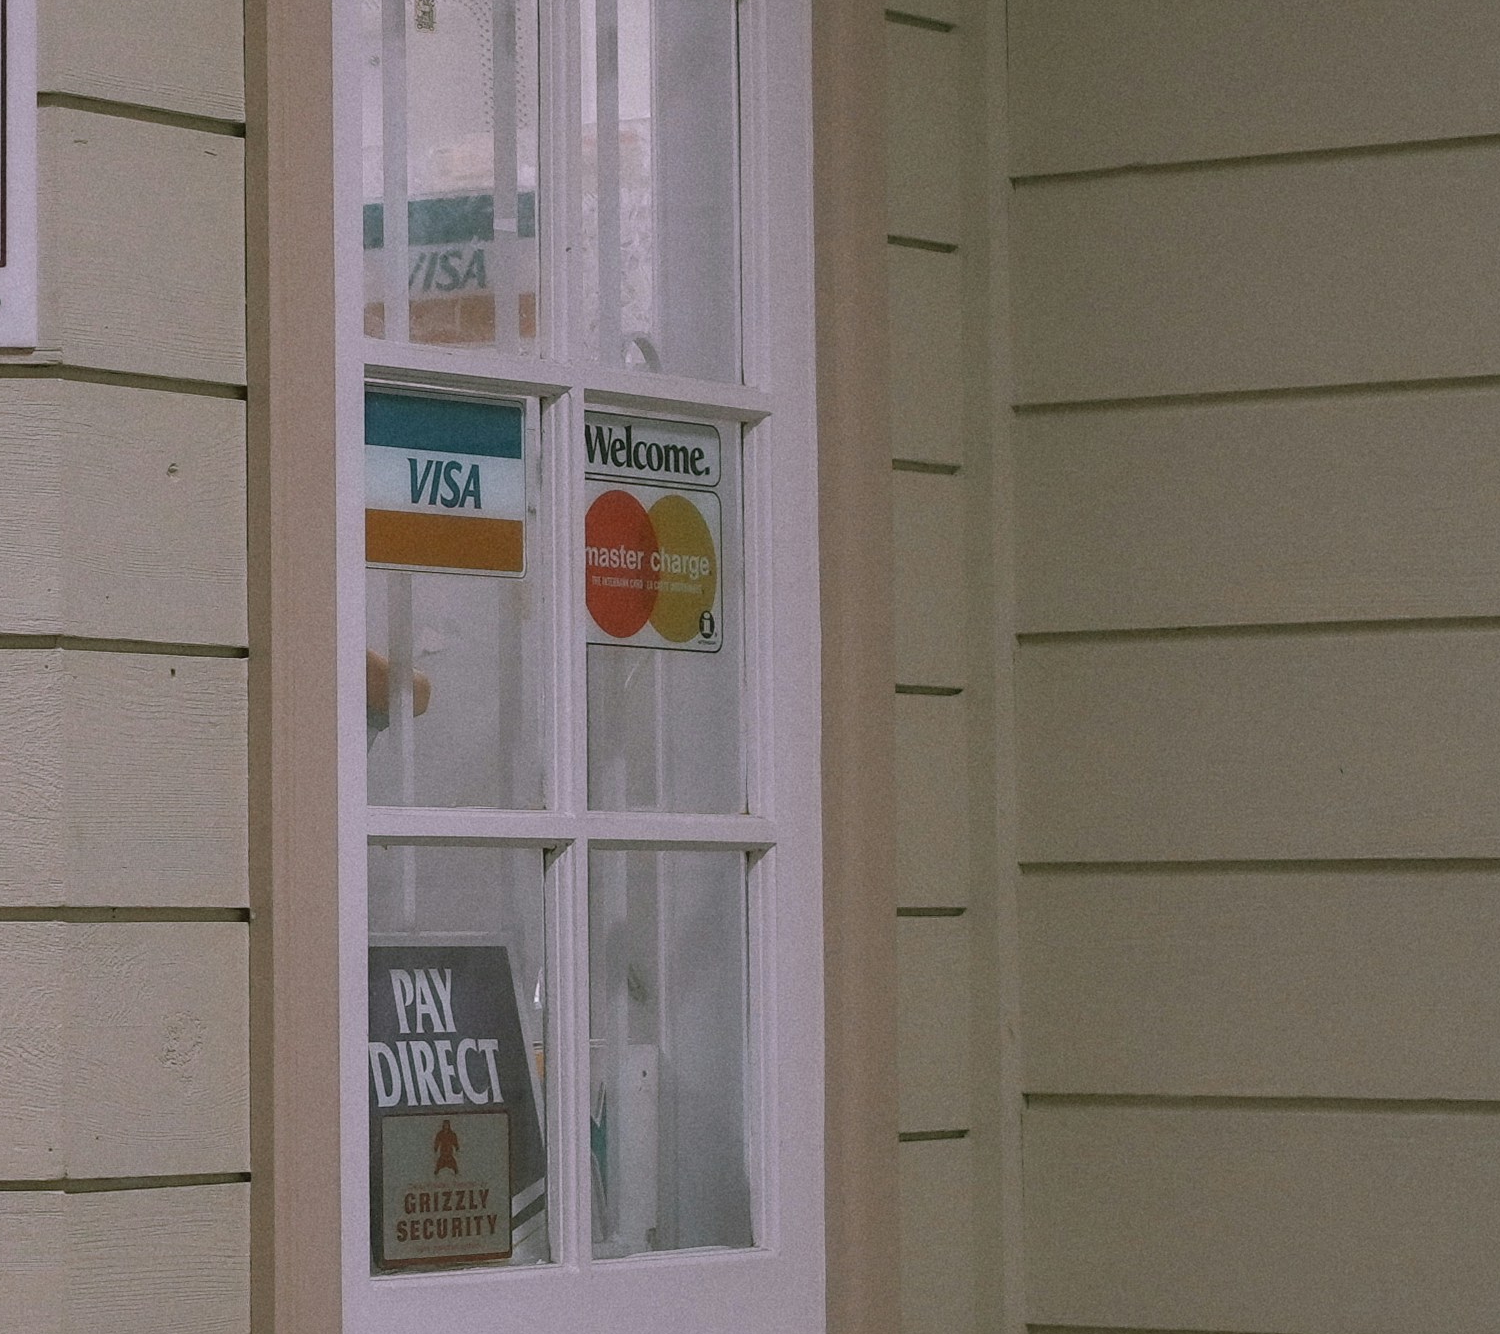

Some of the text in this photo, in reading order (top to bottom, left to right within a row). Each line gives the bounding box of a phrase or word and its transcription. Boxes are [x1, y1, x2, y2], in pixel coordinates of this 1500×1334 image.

[585, 424, 711, 477] Welcome.
[406, 457, 483, 510] VISA
[585, 545, 710, 580] master charge
[389, 968, 457, 1034] PAY
[368, 1038, 504, 1108] DIRECT
[396, 1214, 498, 1242] SECURITY
[404, 1189, 490, 1215] GRIZZLY
